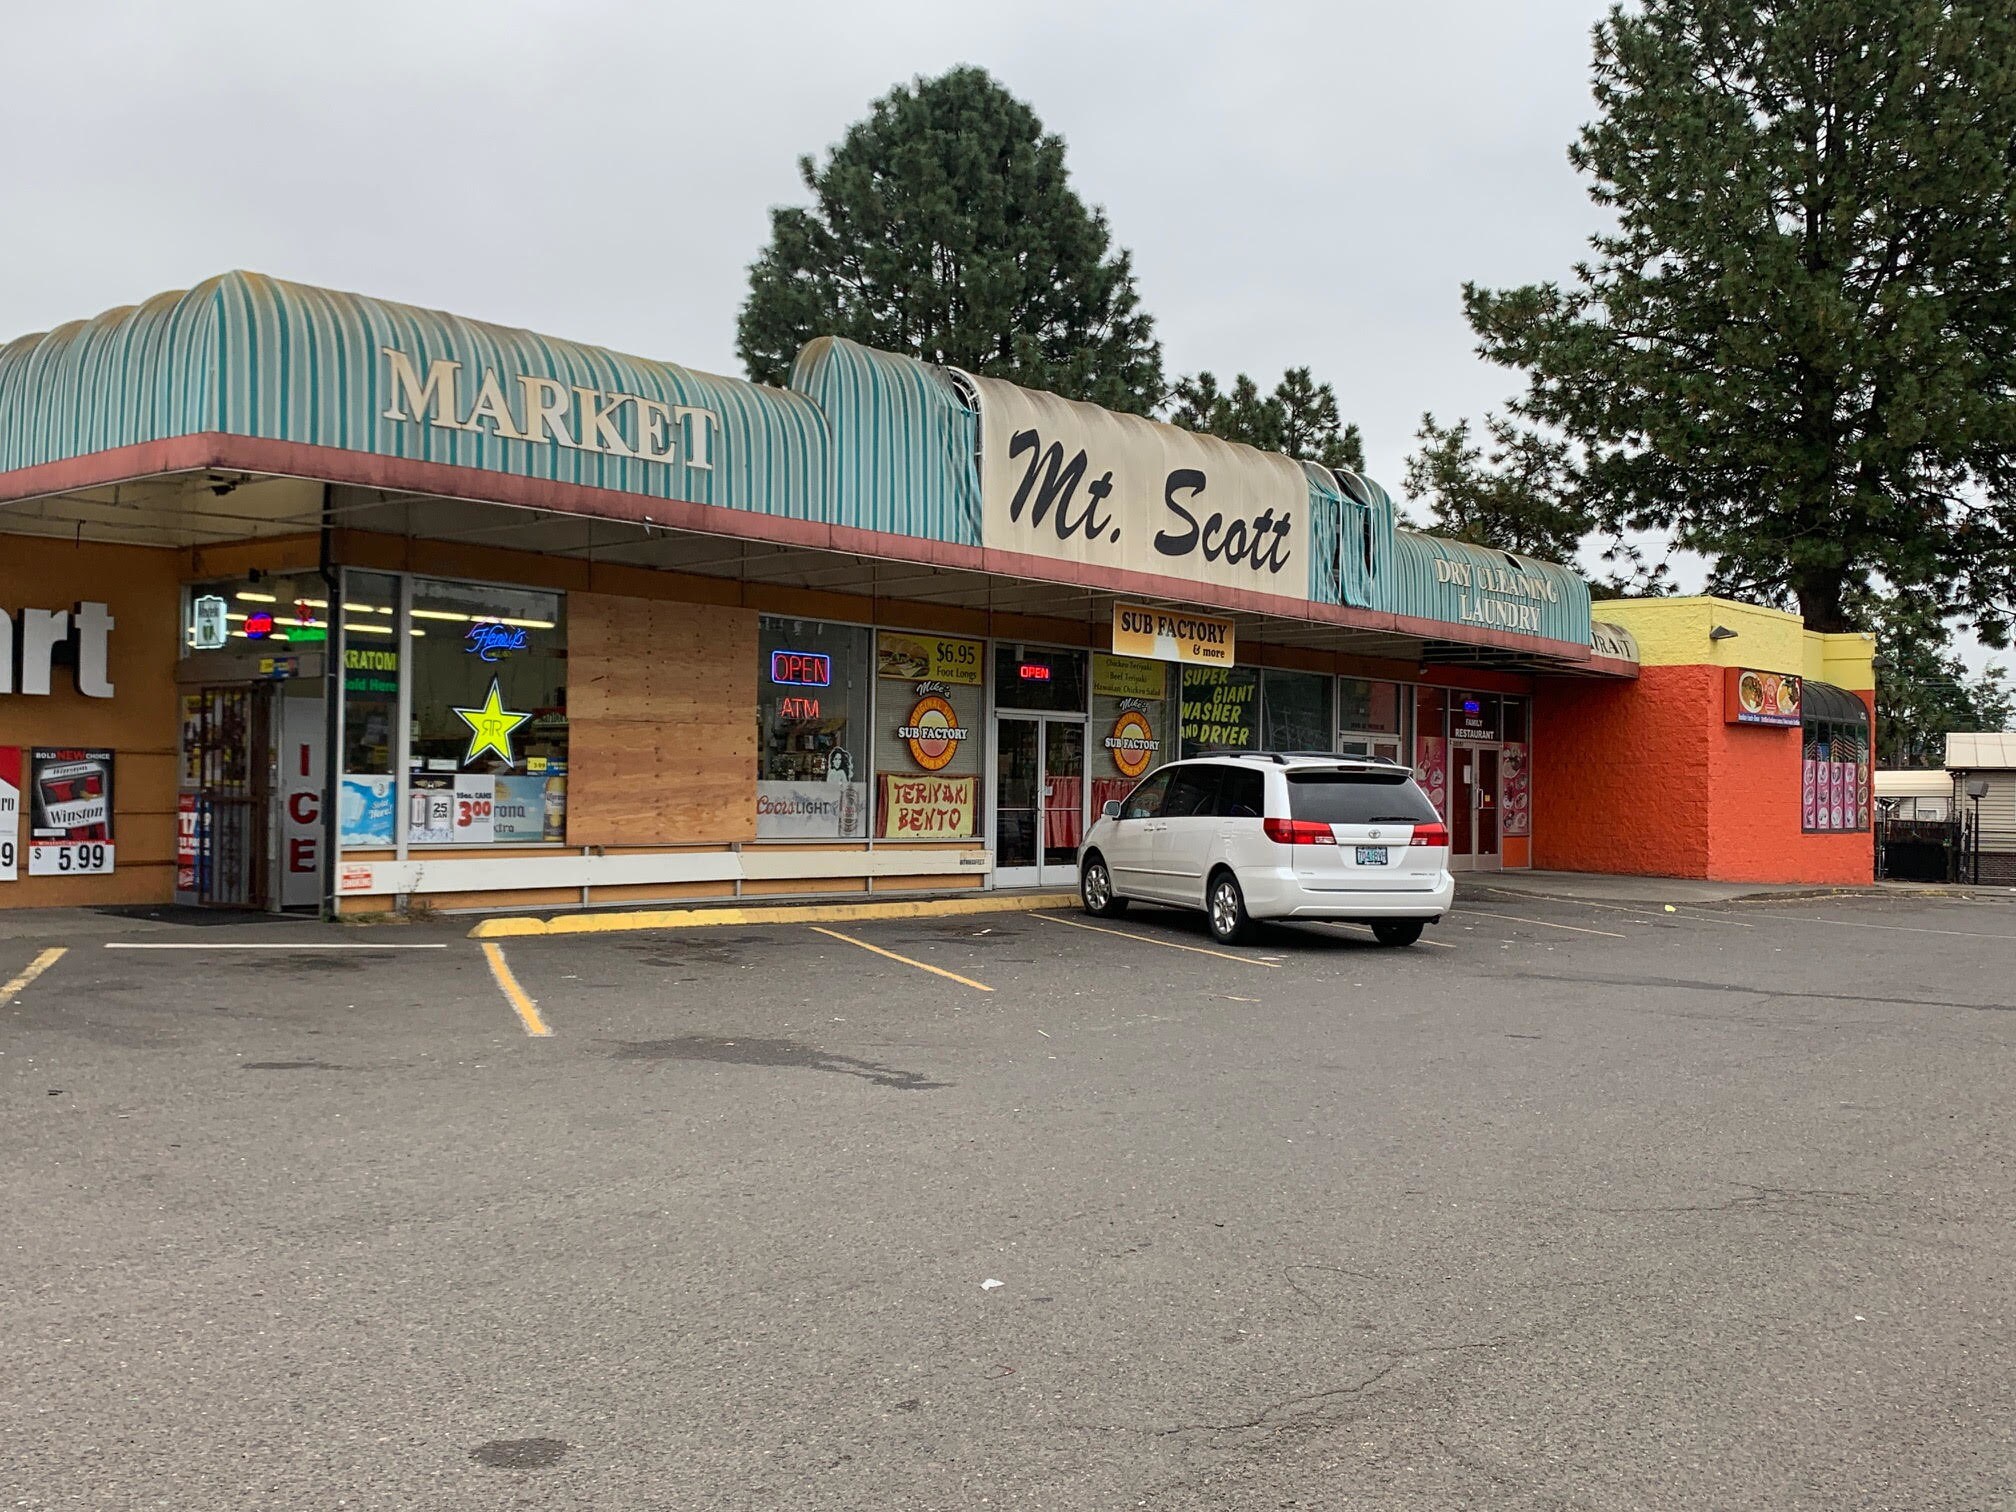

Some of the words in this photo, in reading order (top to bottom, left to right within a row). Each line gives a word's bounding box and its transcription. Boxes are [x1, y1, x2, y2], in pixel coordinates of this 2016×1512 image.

[382, 347, 719, 470] MARKET
[1009, 429, 1120, 543] Mt.
[1154, 468, 1291, 574] Scott
[1434, 558, 1471, 587] DRY
[1476, 566, 1558, 604] CLEANING
[1459, 594, 1540, 632] LAUNDRY
[1121, 611, 1153, 635] SUB
[1157, 615, 1227, 644] FACTORY
[936, 642, 976, 665] $6.95
[1193, 644, 1200, 656] &
[1203, 647, 1225, 659] more
[774, 654, 827, 683] OPEN
[937, 666, 953, 678] Foot
[956, 667, 977, 681] Longs
[1021, 666, 1049, 679] OPEN
[1106, 659, 1128, 668] Chicken
[1130, 661, 1152, 672] Teriyaki
[370, 679, 398, 692] Here
[1109, 672, 1123, 681] Beef
[1125, 673, 1147, 684] Teriyaki
[1184, 669, 1229, 686] SUPER
[916, 681, 951, 699] Mike's
[1123, 685, 1145, 695] Chicken
[1146, 687, 1160, 696] Salad
[1213, 685, 1255, 703] GIANT
[780, 697, 820, 720] ATM
[1120, 698, 1149, 713] Mike's
[1180, 701, 1241, 723] WASHER
[1465, 718, 1482, 727] FAMILY
[898, 727, 919, 739] SUB
[922, 728, 968, 740] FACTORY
[1180, 724, 1198, 739] AND
[1200, 724, 1250, 745] DRYER
[1455, 728, 1495, 739] RESTAURANT
[1105, 737, 1122, 748] SUB
[1124, 738, 1159, 751] FACTORY
[57, 750, 84, 761] NEW
[894, 782, 968, 805] TERIYAKI
[289, 744, 318, 873] ICE
[434, 803, 447, 813] 25
[757, 795, 794, 815] Coors
[795, 801, 830, 815] LIGHT
[50, 807, 103, 824] Winston
[897, 807, 961, 831] BENTO
[34, 847, 41, 859] $
[59, 844, 104, 871] 5.99
